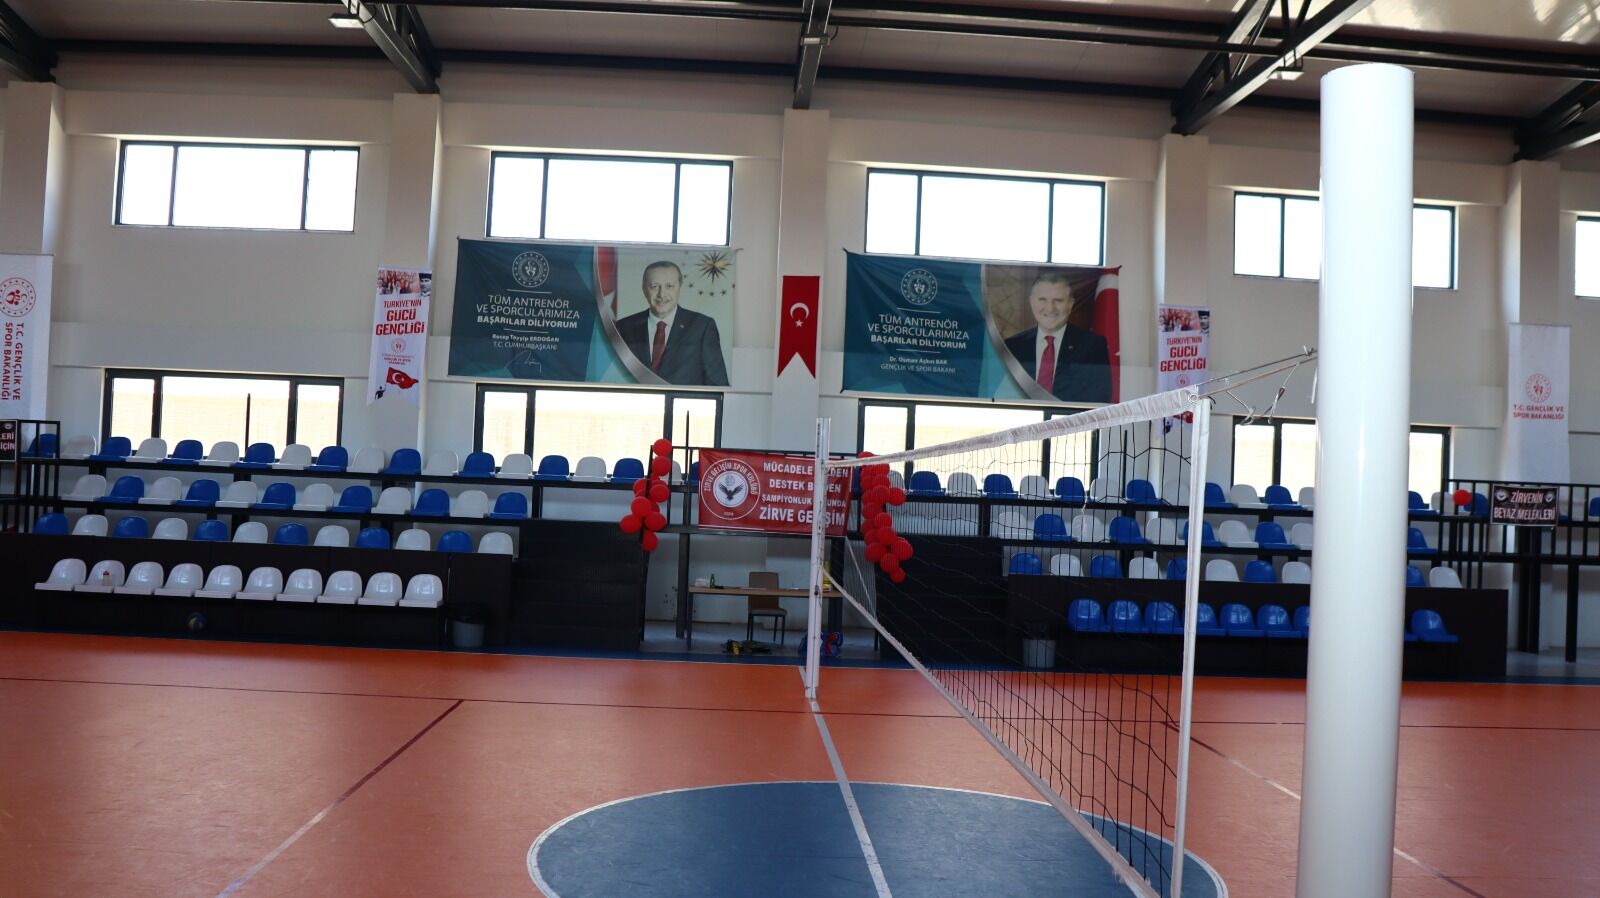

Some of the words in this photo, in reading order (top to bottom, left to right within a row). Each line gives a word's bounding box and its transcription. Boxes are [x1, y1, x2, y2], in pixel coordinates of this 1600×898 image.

[488, 294, 511, 305] TÜM
[513, 297, 569, 309] ANTRENÖR
[386, 309, 417, 322] GÜCÜ
[476, 304, 488, 313] VE
[490, 305, 580, 319] SPORCULARIMIZA
[375, 321, 425, 336] GENÇLİĞİ
[477, 315, 526, 326] BAŞARILAR
[527, 318, 577, 329] DİLİYORUM
[879, 313, 901, 325] TÜM
[904, 316, 958, 329] ANTRENÖR
[4, 322, 14, 347] SPOR
[15, 323, 25, 339] T.C.
[867, 323, 880, 333] VE
[882, 324, 970, 340] SPORCULARIMIZA
[870, 335, 918, 346] BAŞARILAR
[919, 338, 966, 349] DİLİYORUM
[13, 342, 23, 384] GENÇLİK
[1, 349, 12, 401] BAKANLIĞI
[12, 388, 21, 401] VE
[763, 461, 813, 476] MÜCADELE
[769, 478, 805, 491] DESTEK
[761, 493, 812, 505] ŞAMPİYONLUK
[759, 504, 794, 522] ZİRVE
[1494, 507, 1516, 519] BEYAZ
